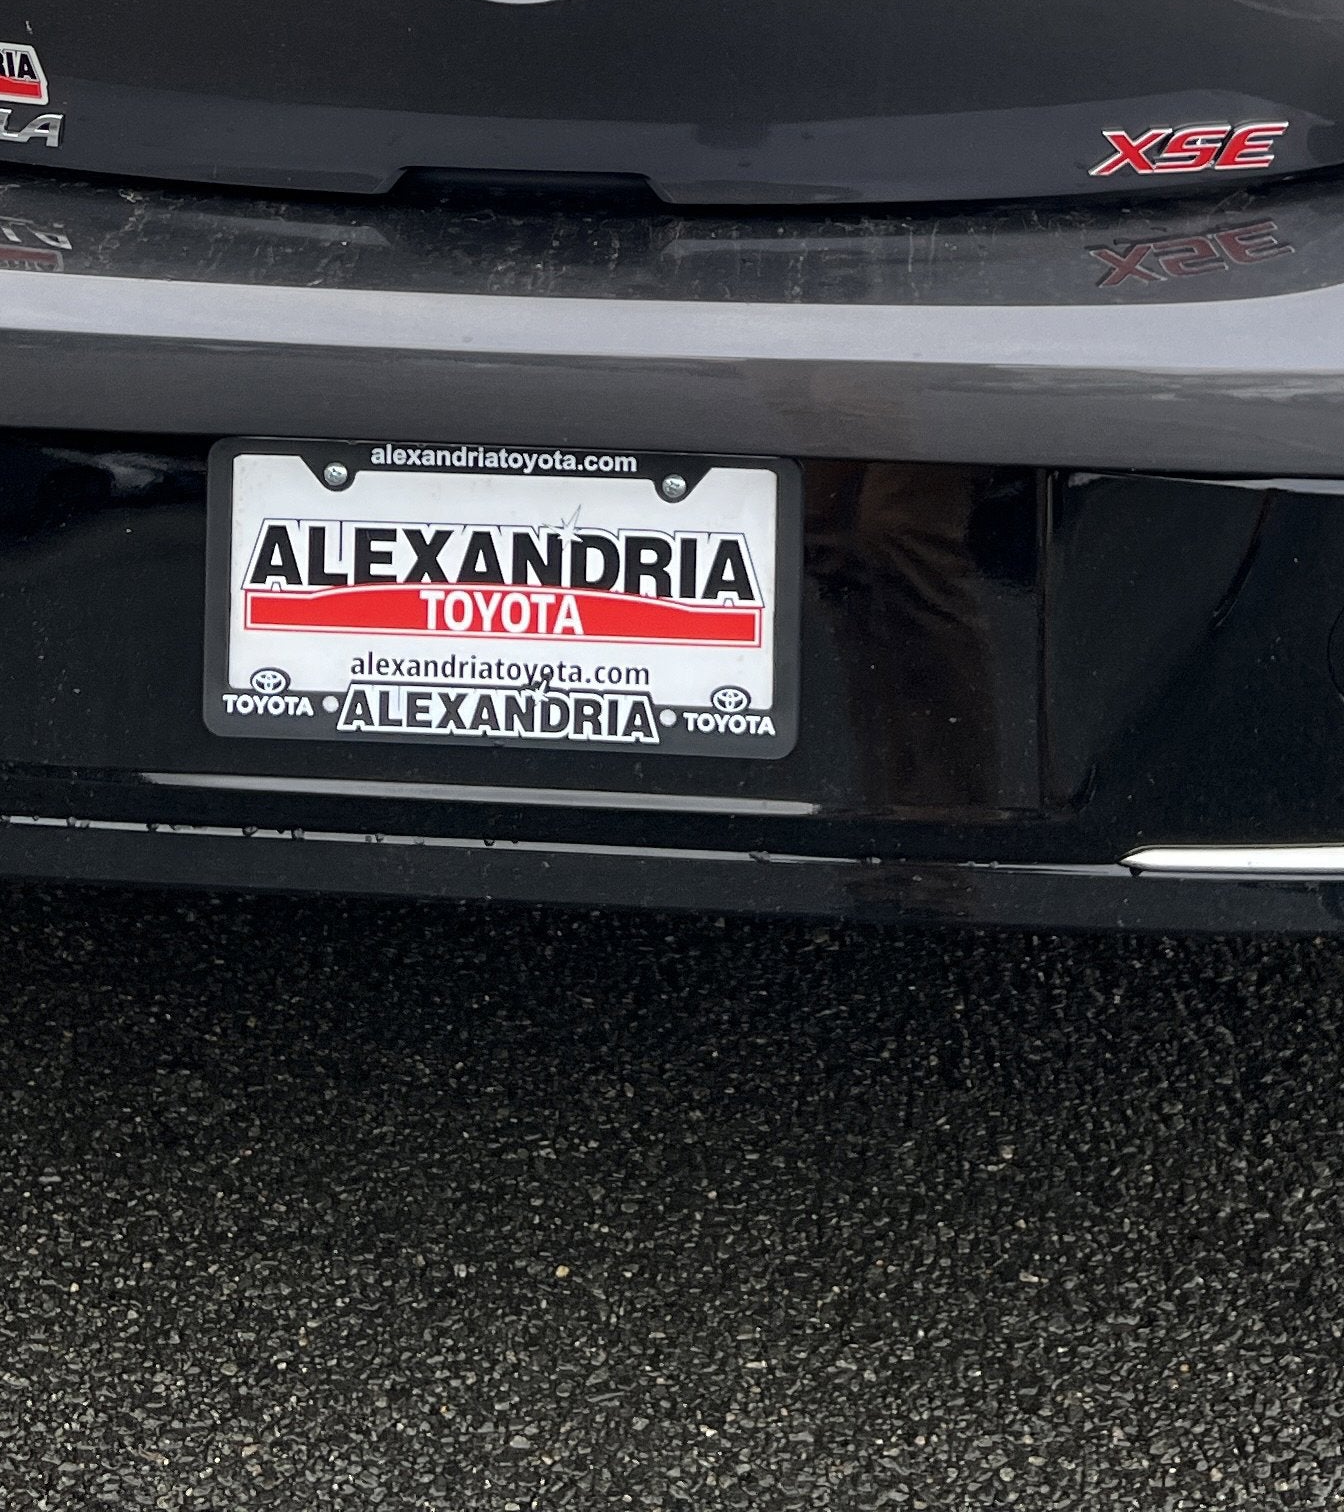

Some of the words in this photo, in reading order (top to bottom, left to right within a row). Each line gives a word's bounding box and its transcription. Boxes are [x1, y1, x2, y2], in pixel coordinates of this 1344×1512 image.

[1088, 121, 1289, 175] XSE
[370, 446, 638, 474] alexandriatoyota.com
[248, 524, 758, 602] ALEXANDRIA
[420, 590, 584, 635] TOYOTA
[351, 652, 650, 687] alexandriatoyota.com
[222, 694, 314, 717] TOYOTA
[340, 691, 659, 743] ALEXANDRIA
[683, 710, 776, 737] TOYOTA
